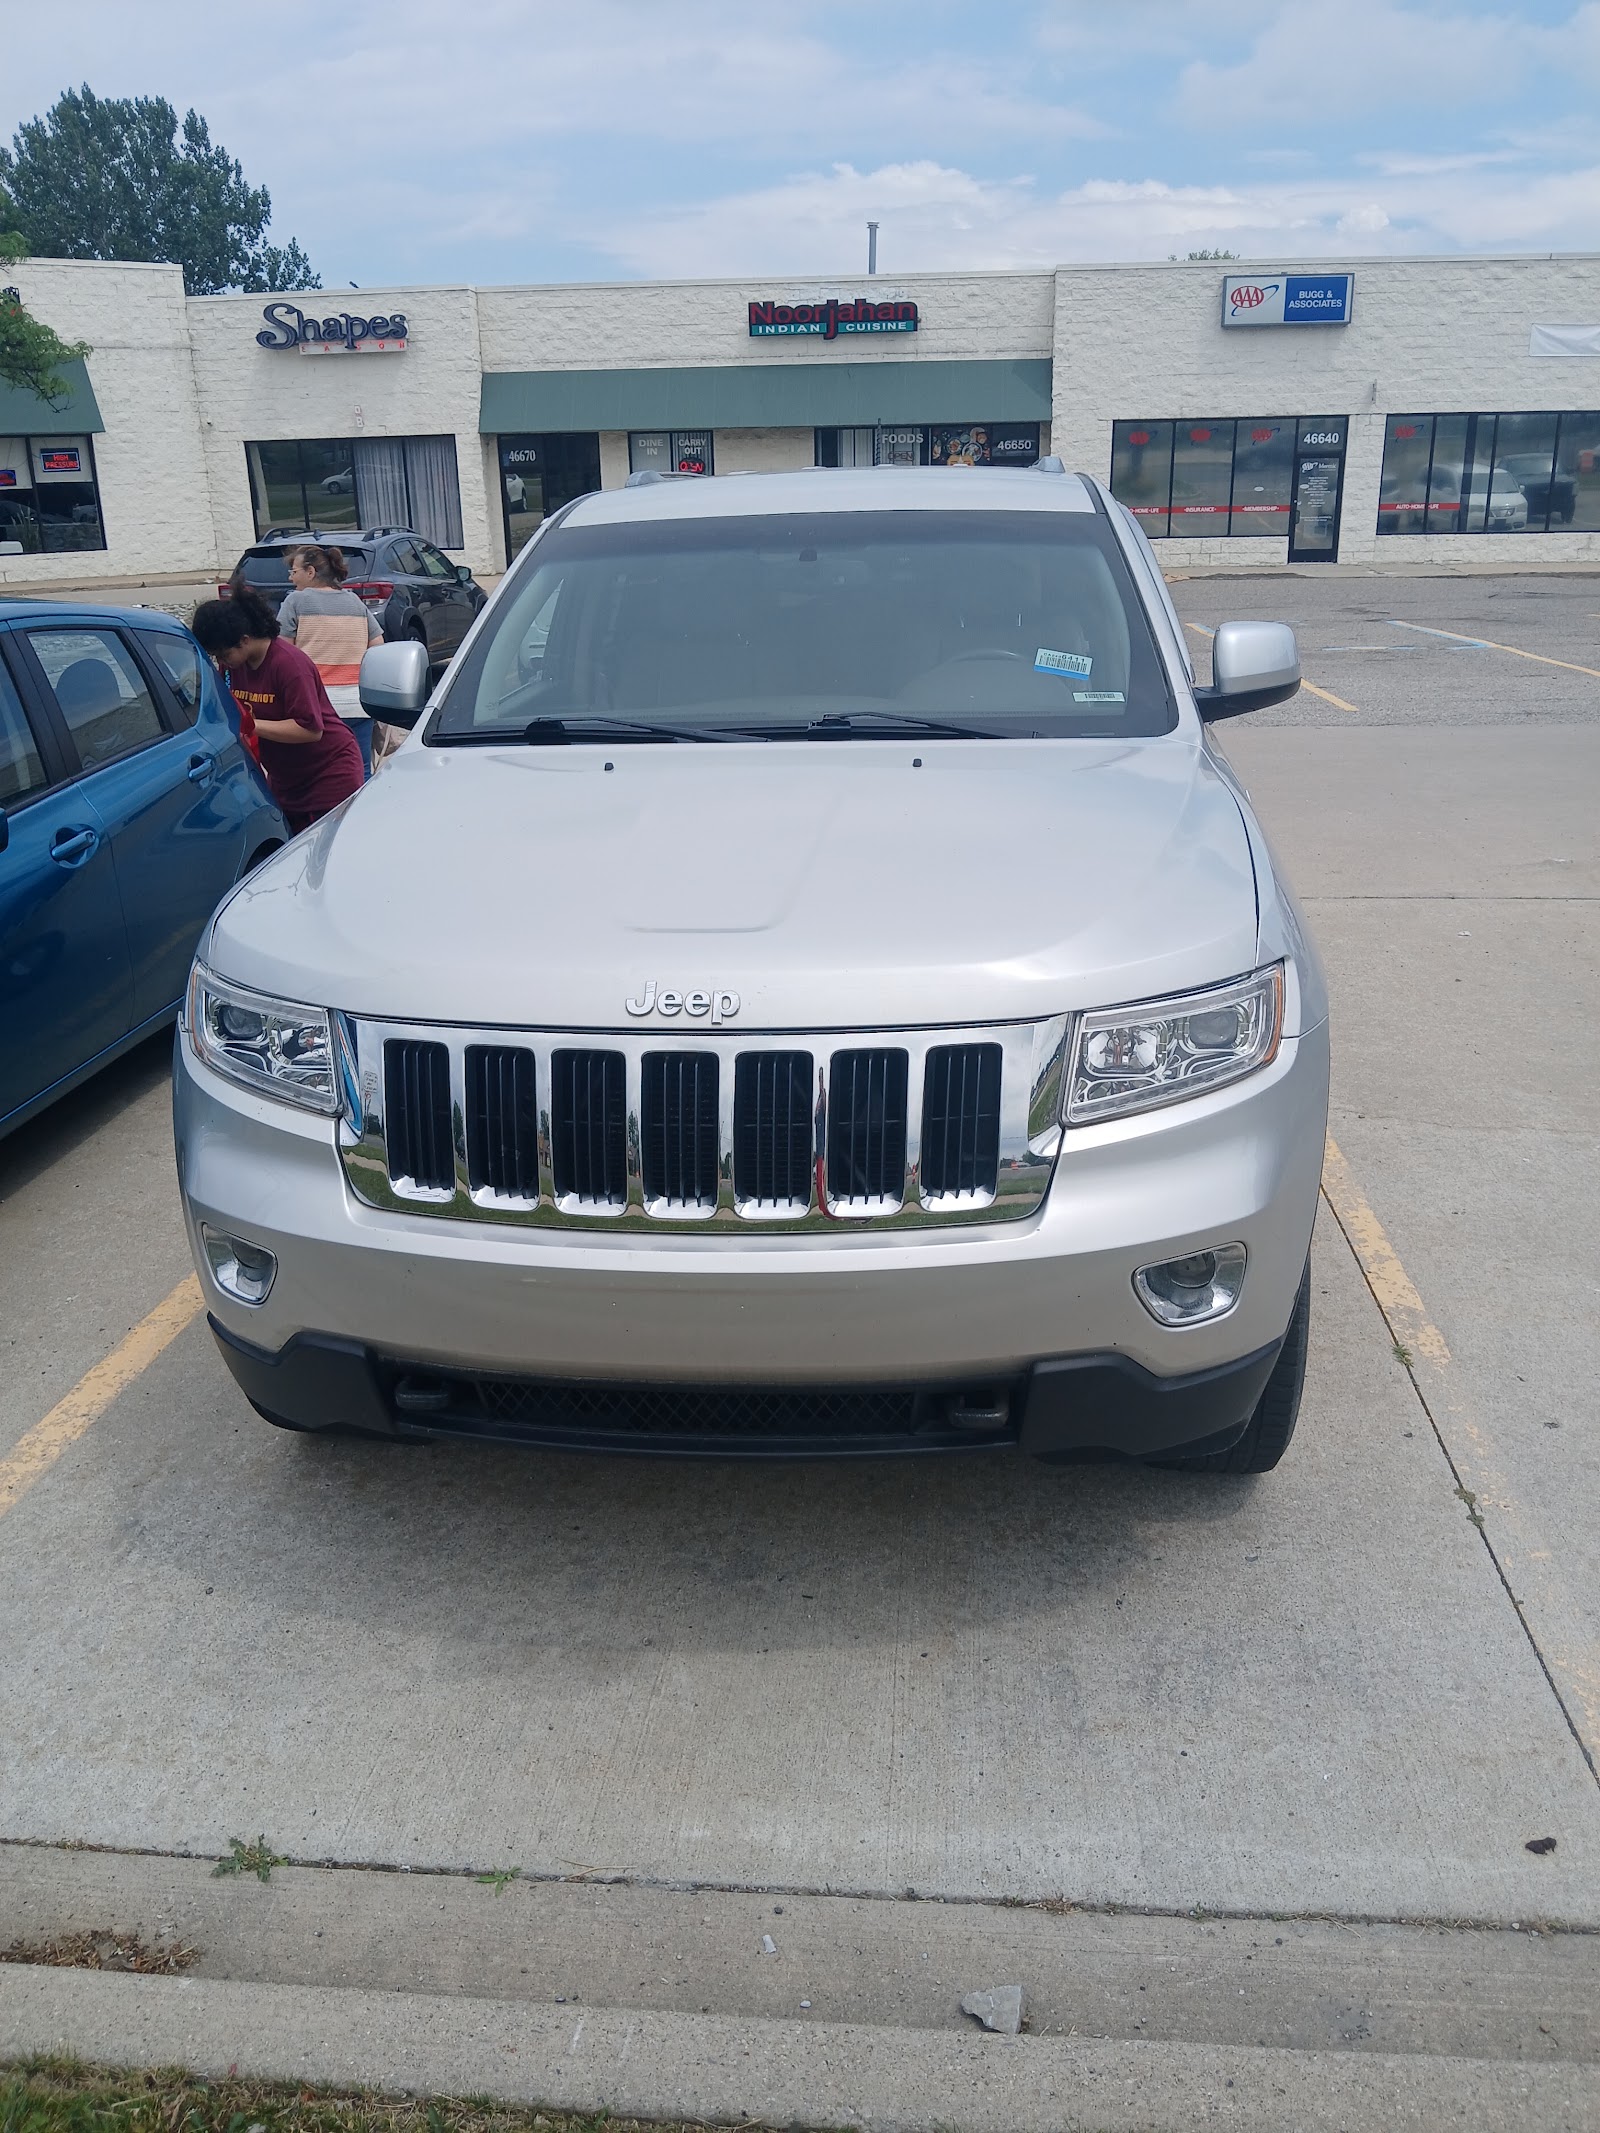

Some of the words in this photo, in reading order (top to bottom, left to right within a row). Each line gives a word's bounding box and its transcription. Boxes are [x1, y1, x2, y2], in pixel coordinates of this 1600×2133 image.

[1232, 286, 1264, 308] AAA
[1298, 290, 1324, 298] BUGG
[1326, 290, 1333, 298] &
[1288, 299, 1342, 308] ASSOCIATES
[750, 301, 915, 339] Noorjahan
[256, 302, 408, 350] Shapes
[758, 324, 821, 334] INDIAN
[845, 321, 906, 332] CUISINE
[638, 439, 664, 447] DINE
[678, 438, 707, 447] CARRY
[882, 433, 924, 444] FOODS
[1303, 432, 1339, 444] 46640
[997, 440, 1032, 450] 46650
[508, 450, 536, 462] 46670
[646, 447, 658, 456] IN
[684, 447, 702, 455] OUT
[625, 981, 741, 1025] Jeep
